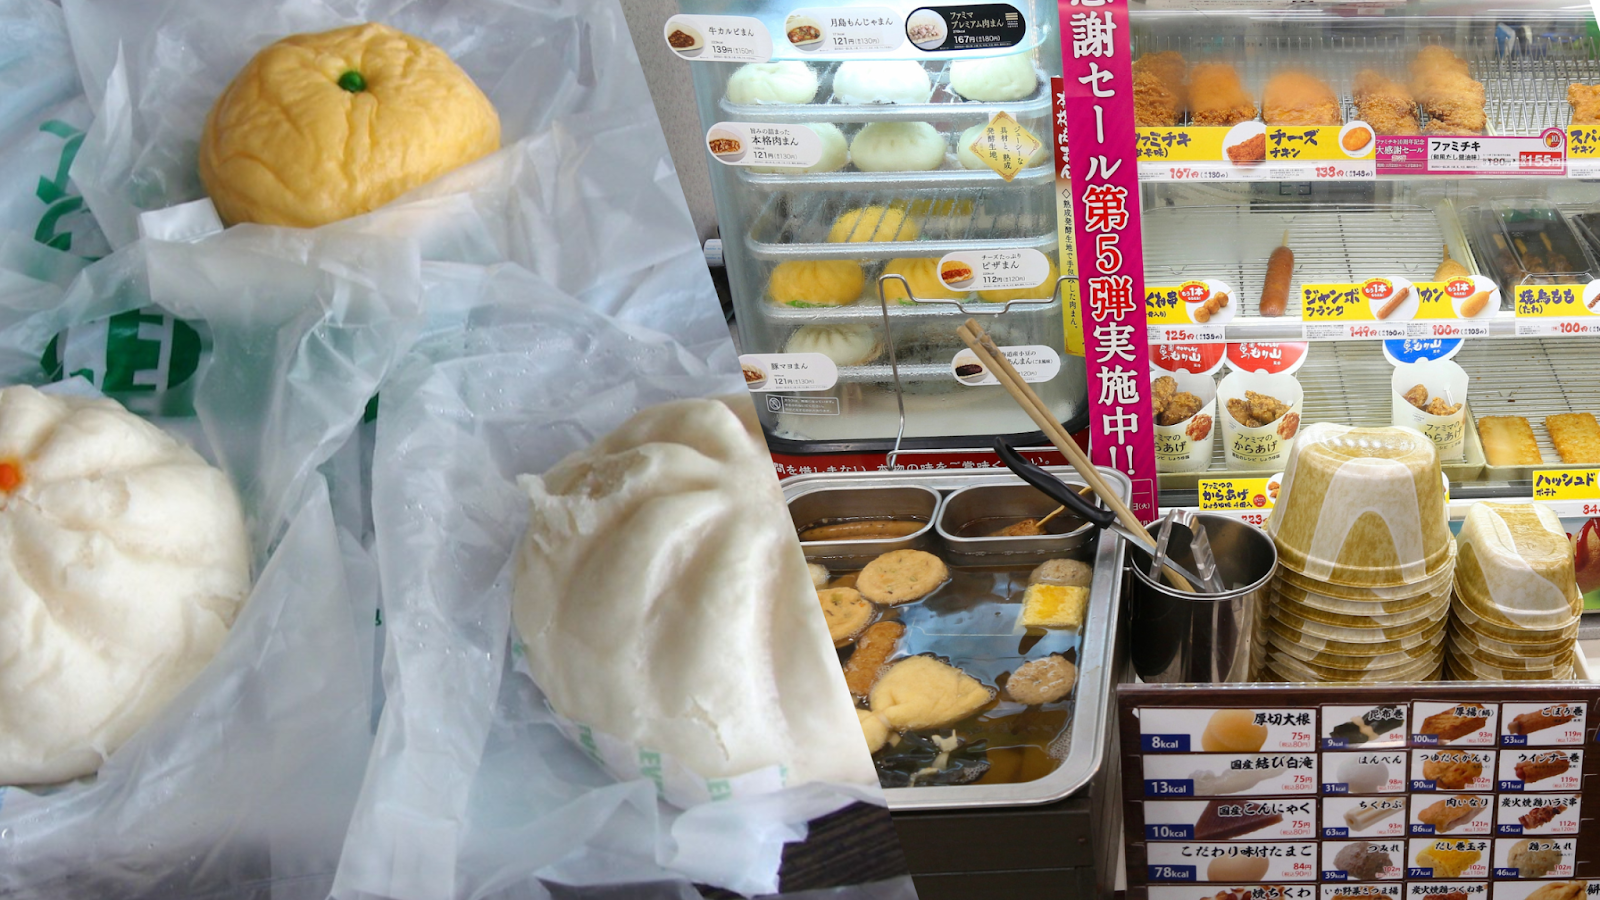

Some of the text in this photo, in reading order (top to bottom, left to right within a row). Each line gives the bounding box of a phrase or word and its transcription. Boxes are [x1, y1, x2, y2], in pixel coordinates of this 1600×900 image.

[949, 11, 974, 20] ファミマ
[830, 17, 894, 27] 月島もんじゃまん
[951, 19, 1004, 29] プレミアム肉まん
[708, 26, 755, 37] 牛カルビまん
[751, 135, 799, 146] 本格肉まん
[1269, 128, 1320, 147] チーズ
[1570, 129, 1600, 145] スパ
[1376, 145, 1425, 155] 大感謝セール
[1431, 141, 1481, 152] ファミチキ
[1571, 145, 1596, 154] チキン
[1269, 147, 1301, 158] チキン
[1169, 167, 1199, 179] 167円
[1315, 166, 1344, 178] 138円
[1070, 0, 1141, 475] 謝セール第5弾実施中!!
[982, 260, 1020, 270] ピザまん
[1304, 287, 1360, 306] ジャンボ
[1519, 288, 1575, 305] 焼鳥もも
[1306, 305, 1344, 317] フランク
[1518, 304, 1543, 315] (たれ)
[1350, 325, 1377, 337] 149円
[1432, 324, 1460, 335] 100円
[1560, 322, 1588, 333] 100円
[1165, 329, 1195, 341] 125円
[1426, 421, 1460, 431] ファミマの
[1237, 433, 1273, 443] ファミマの
[1234, 440, 1278, 454] からあげ
[1535, 472, 1595, 487] ハッシュド
[1202, 482, 1233, 490] ファミマの
[1203, 488, 1249, 501] からあげ
[1536, 487, 1557, 497] ポテト
[1368, 708, 1404, 720] 昆布巻
[1541, 706, 1584, 717] ごぼう巻
[1253, 712, 1311, 726] 厚切大根
[1291, 732, 1311, 740] 75円
[1413, 735, 1438, 743] 100kcal
[1504, 736, 1525, 744] 53kcal
[1151, 736, 1179, 749] 8kcal
[1327, 738, 1344, 747] 9kcal
[1230, 756, 1314, 770] 国産結び白滝
[1419, 753, 1491, 763] つゆだくがんも
[1518, 753, 1580, 763] ウインナー巻
[1293, 775, 1313, 783] 75円
[1151, 781, 1187, 794] 13kcal
[1325, 784, 1347, 792] 31kcal
[1413, 781, 1434, 789] 90kcal
[1359, 800, 1402, 809] ちくわぶ
[1446, 798, 1489, 808] 肉いなり
[1501, 798, 1578, 808] 炭火焼鶏ハラミ串
[1218, 802, 1311, 816] 国産こんにゃく
[1292, 820, 1311, 828] 75円
[1412, 825, 1433, 833] 86kcal
[1499, 825, 1521, 833] 45kcal
[1152, 825, 1187, 838] 10kcal
[1325, 828, 1347, 836] 63kcal
[1368, 844, 1400, 853] つみれ
[1435, 841, 1488, 851] だし巻玉子
[1528, 842, 1573, 852] 鶏つみれ
[1181, 845, 1313, 858] こだわり味付たまご
[1293, 862, 1312, 870] 84円
[1154, 866, 1190, 879] 78kcal
[1324, 871, 1346, 880] 39kcal
[1410, 869, 1431, 877] 77kcal
[1496, 869, 1516, 877] 46kcal
[1251, 887, 1312, 900] 焼ちくわ
[1325, 885, 1399, 896] いか野菜さつま揚
[1411, 885, 1484, 895] 炭火焼鶏つくね串
